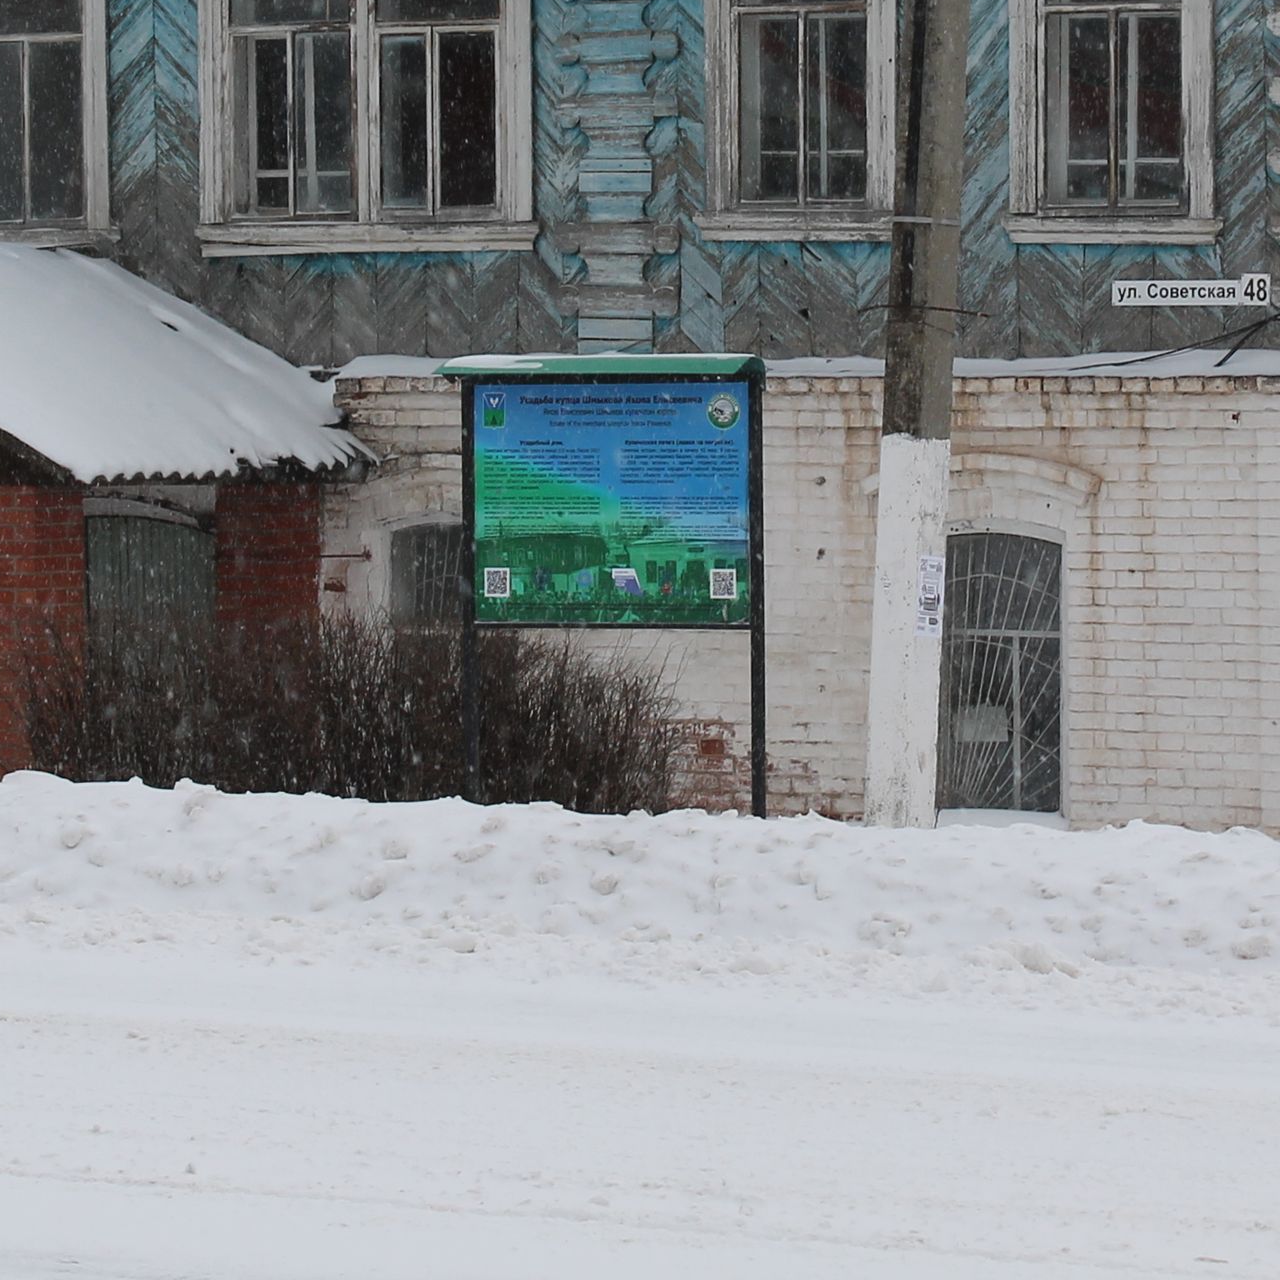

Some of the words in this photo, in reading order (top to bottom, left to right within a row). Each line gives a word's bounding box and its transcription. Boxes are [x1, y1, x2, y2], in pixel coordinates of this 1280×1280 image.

[1117, 286, 1142, 303] ул.
[1147, 283, 1236, 299] Советская
[1243, 278, 1268, 302] 48
